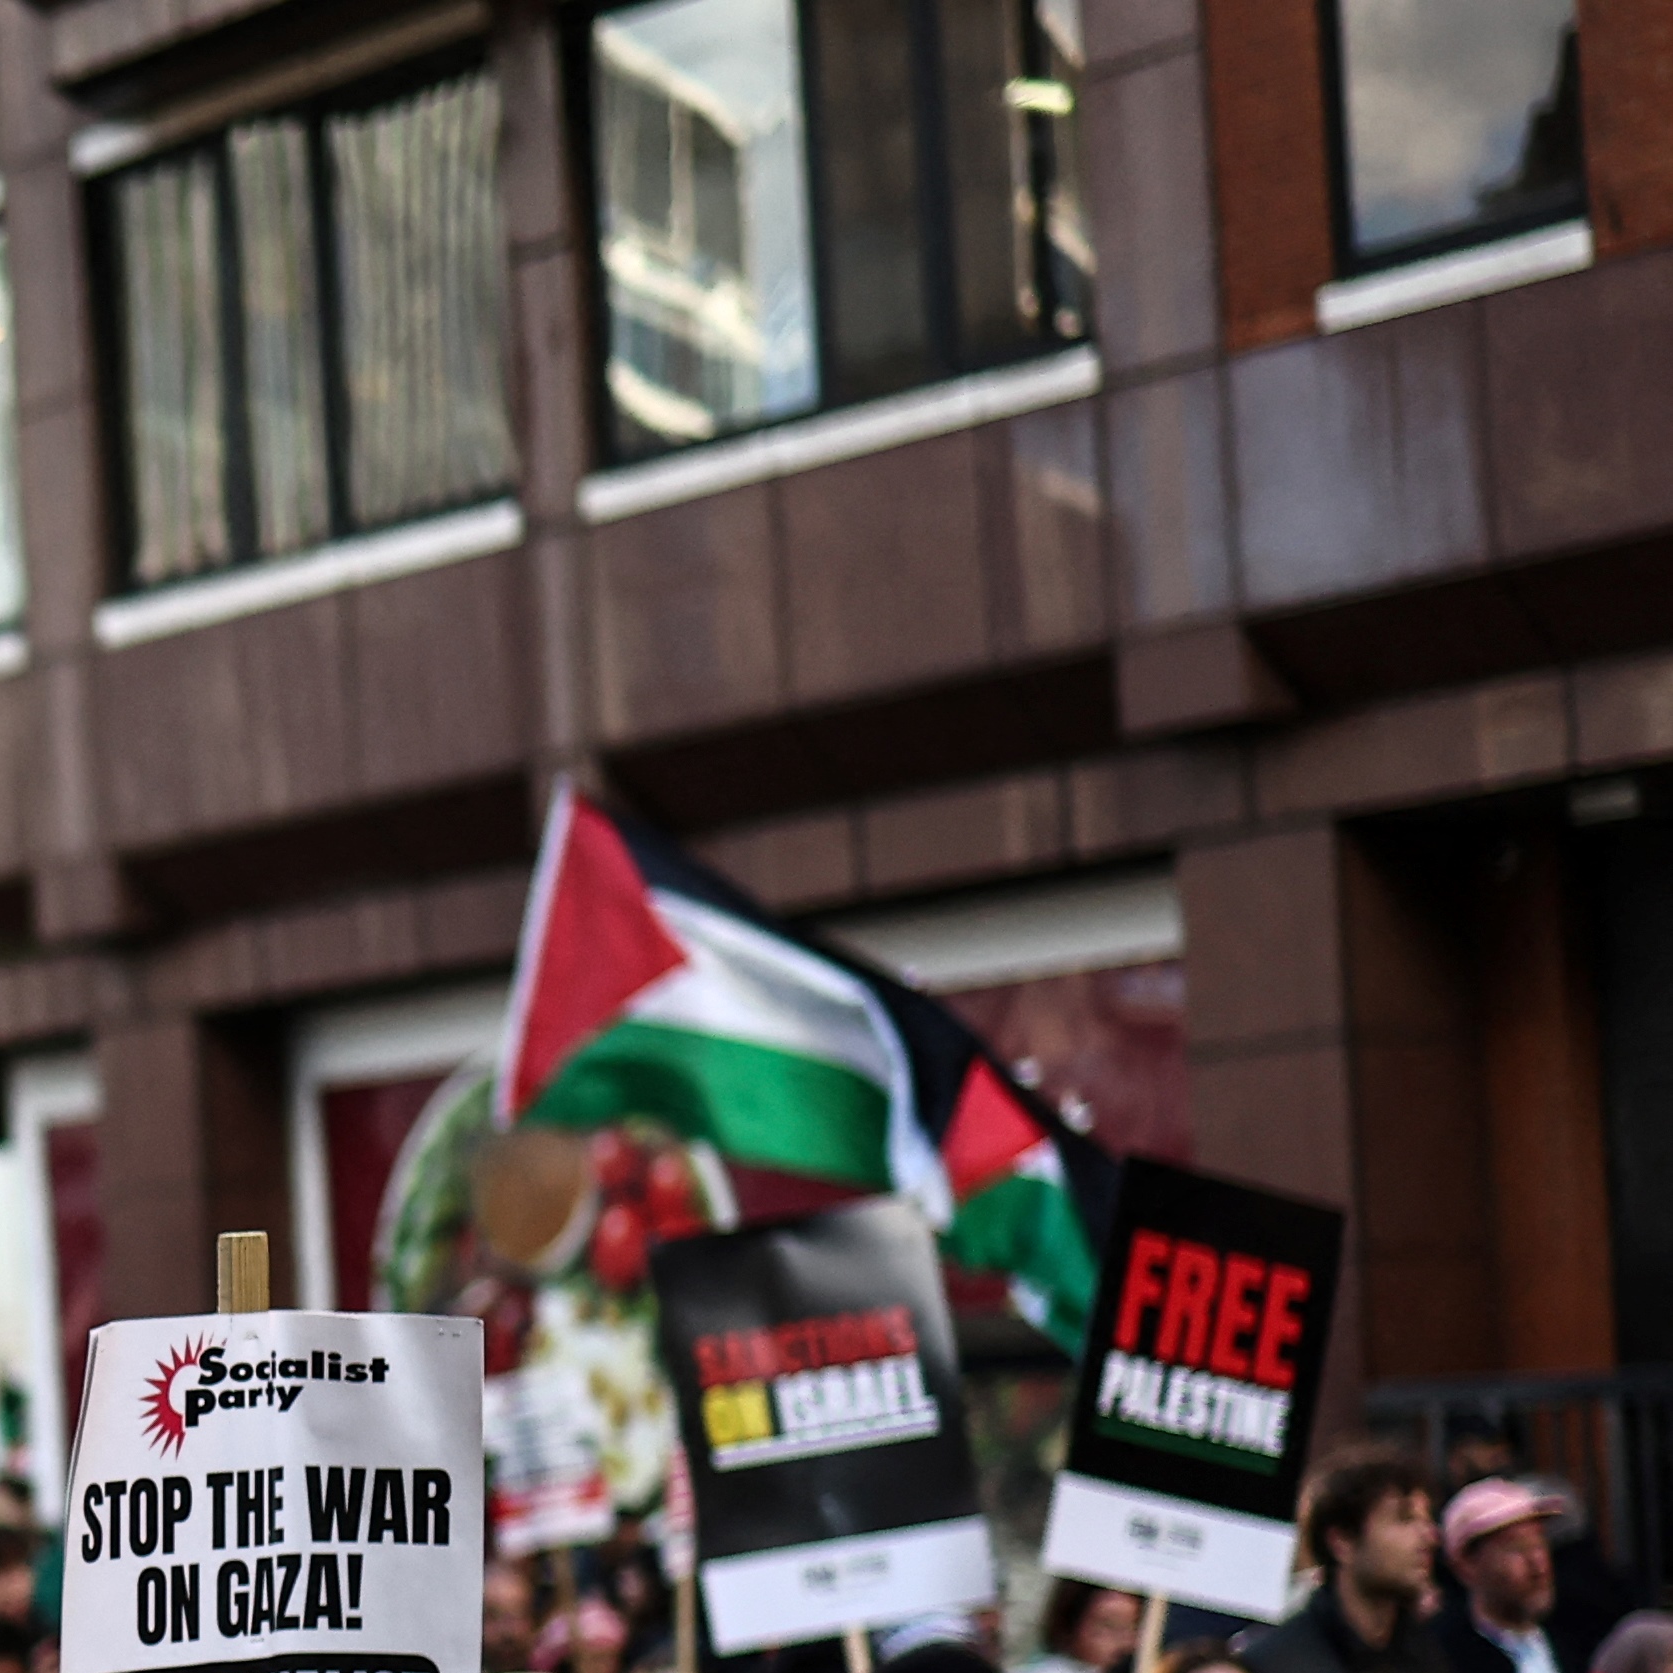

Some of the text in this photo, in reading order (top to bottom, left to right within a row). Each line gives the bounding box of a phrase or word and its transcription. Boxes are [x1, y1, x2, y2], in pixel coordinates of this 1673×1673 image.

[1113, 1226, 1312, 1391] FREE
[184, 1382, 303, 1427] party
[198, 1347, 390, 1386] Socialist
[774, 1354, 934, 1432] ISRAEL
[1096, 1348, 1294, 1460] PALESTINE
[81, 1466, 452, 1563] STOP THE WAR
[137, 1553, 363, 1646] ON GAZA!
